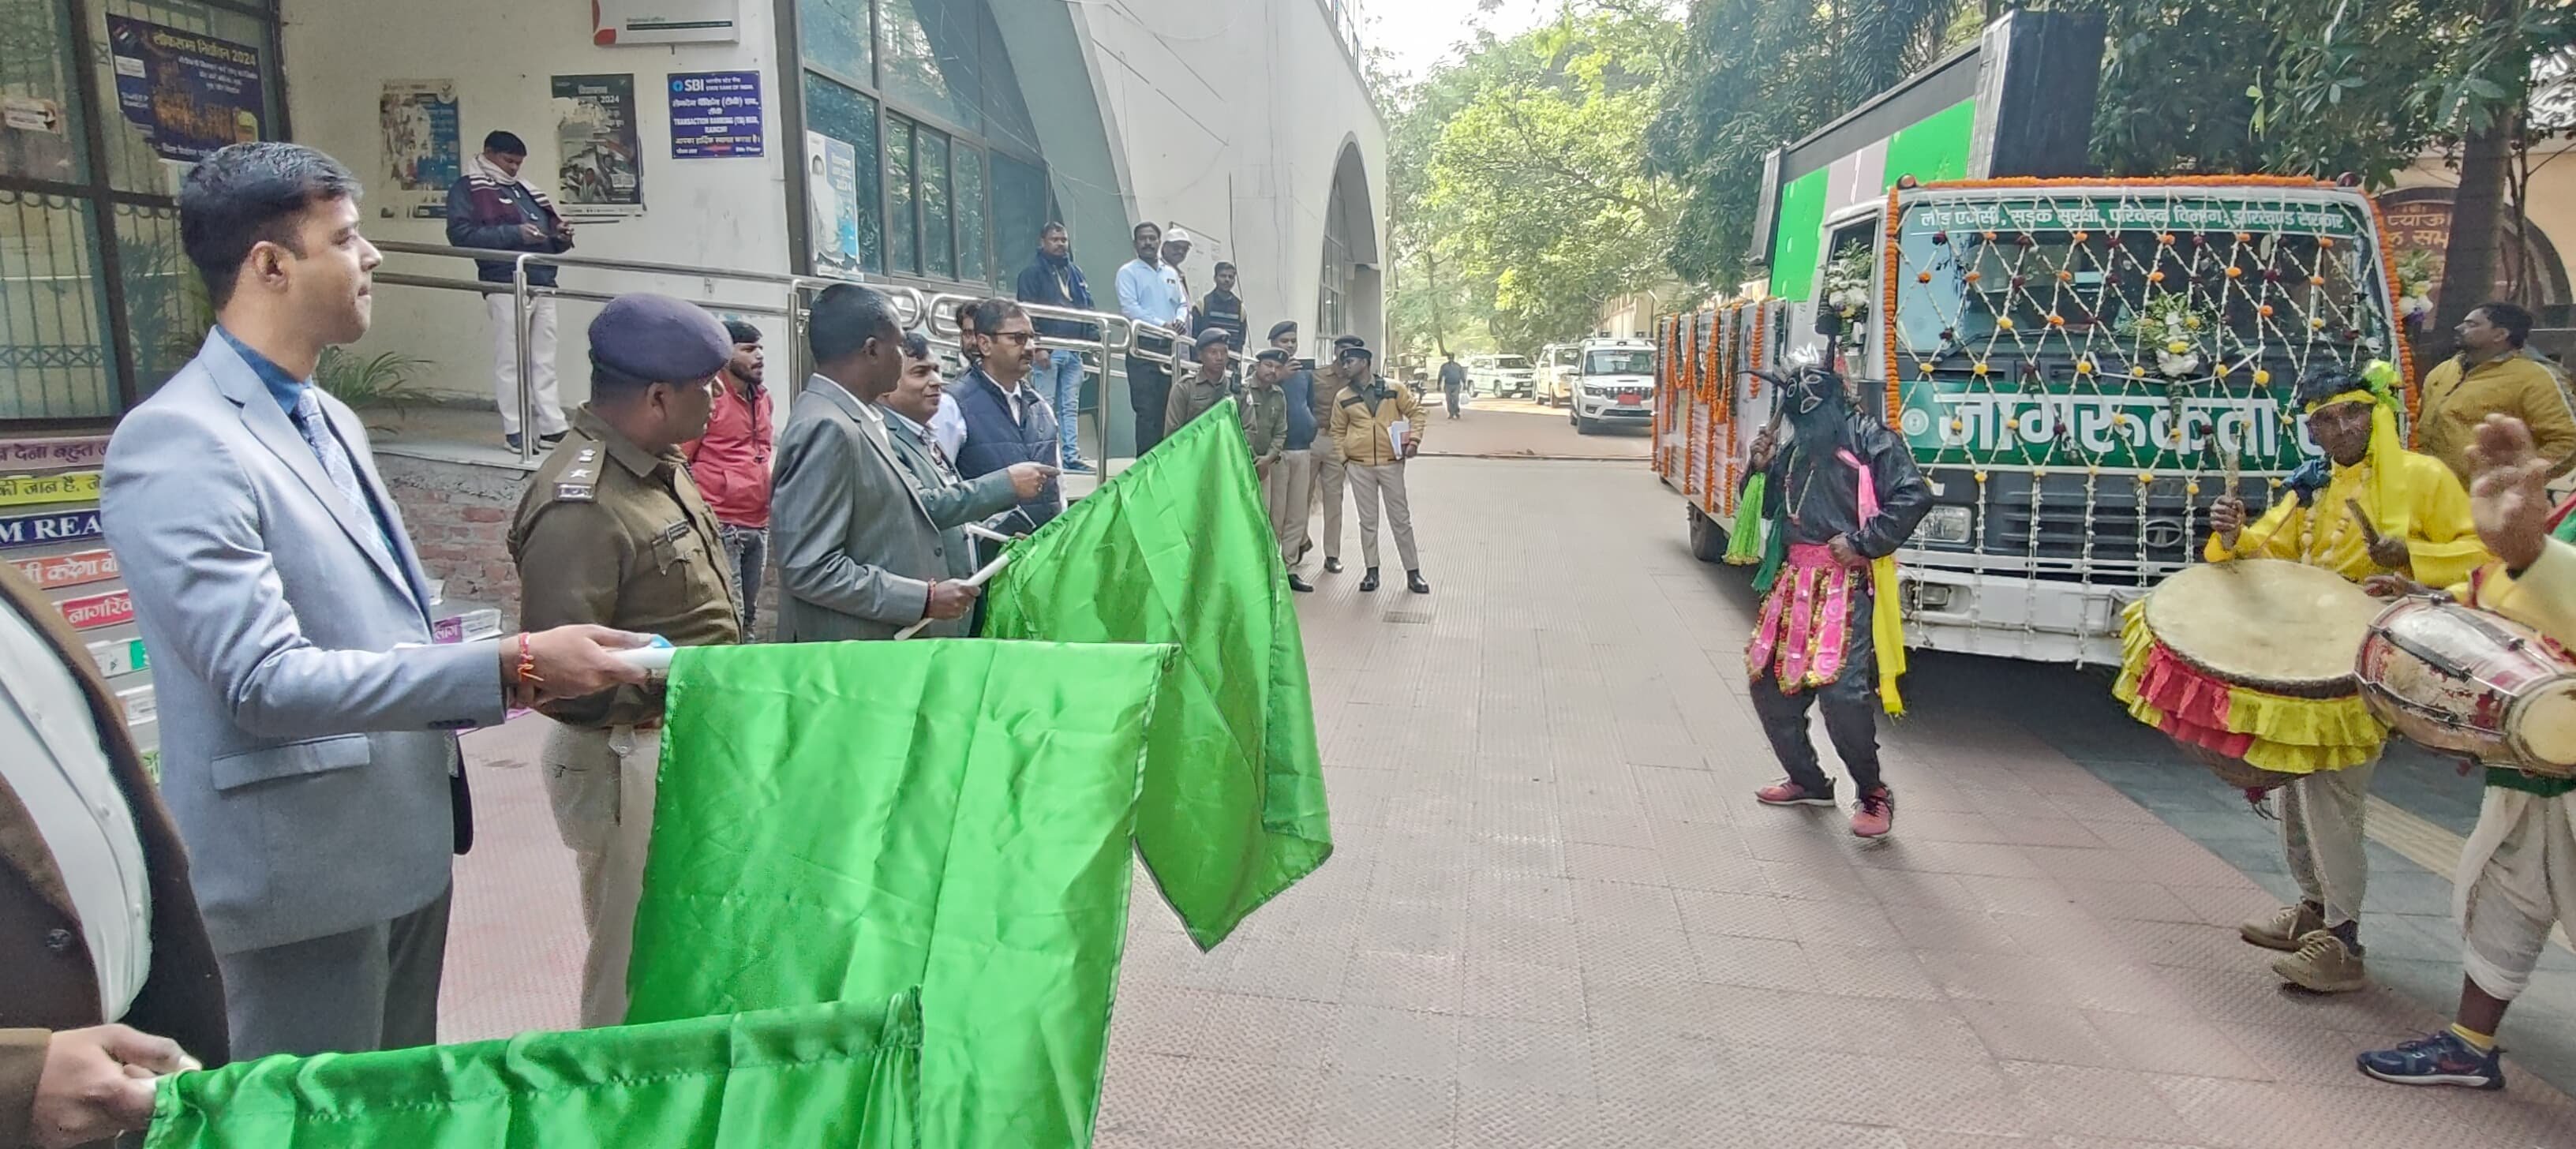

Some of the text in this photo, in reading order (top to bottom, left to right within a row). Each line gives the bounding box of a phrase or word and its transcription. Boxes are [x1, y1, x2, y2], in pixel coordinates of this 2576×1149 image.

[232, 49, 256, 66] 2024
[684, 79, 705, 92] SBI
[601, 95, 620, 104] 2024
[1934, 392, 2278, 457] जागरूकता
